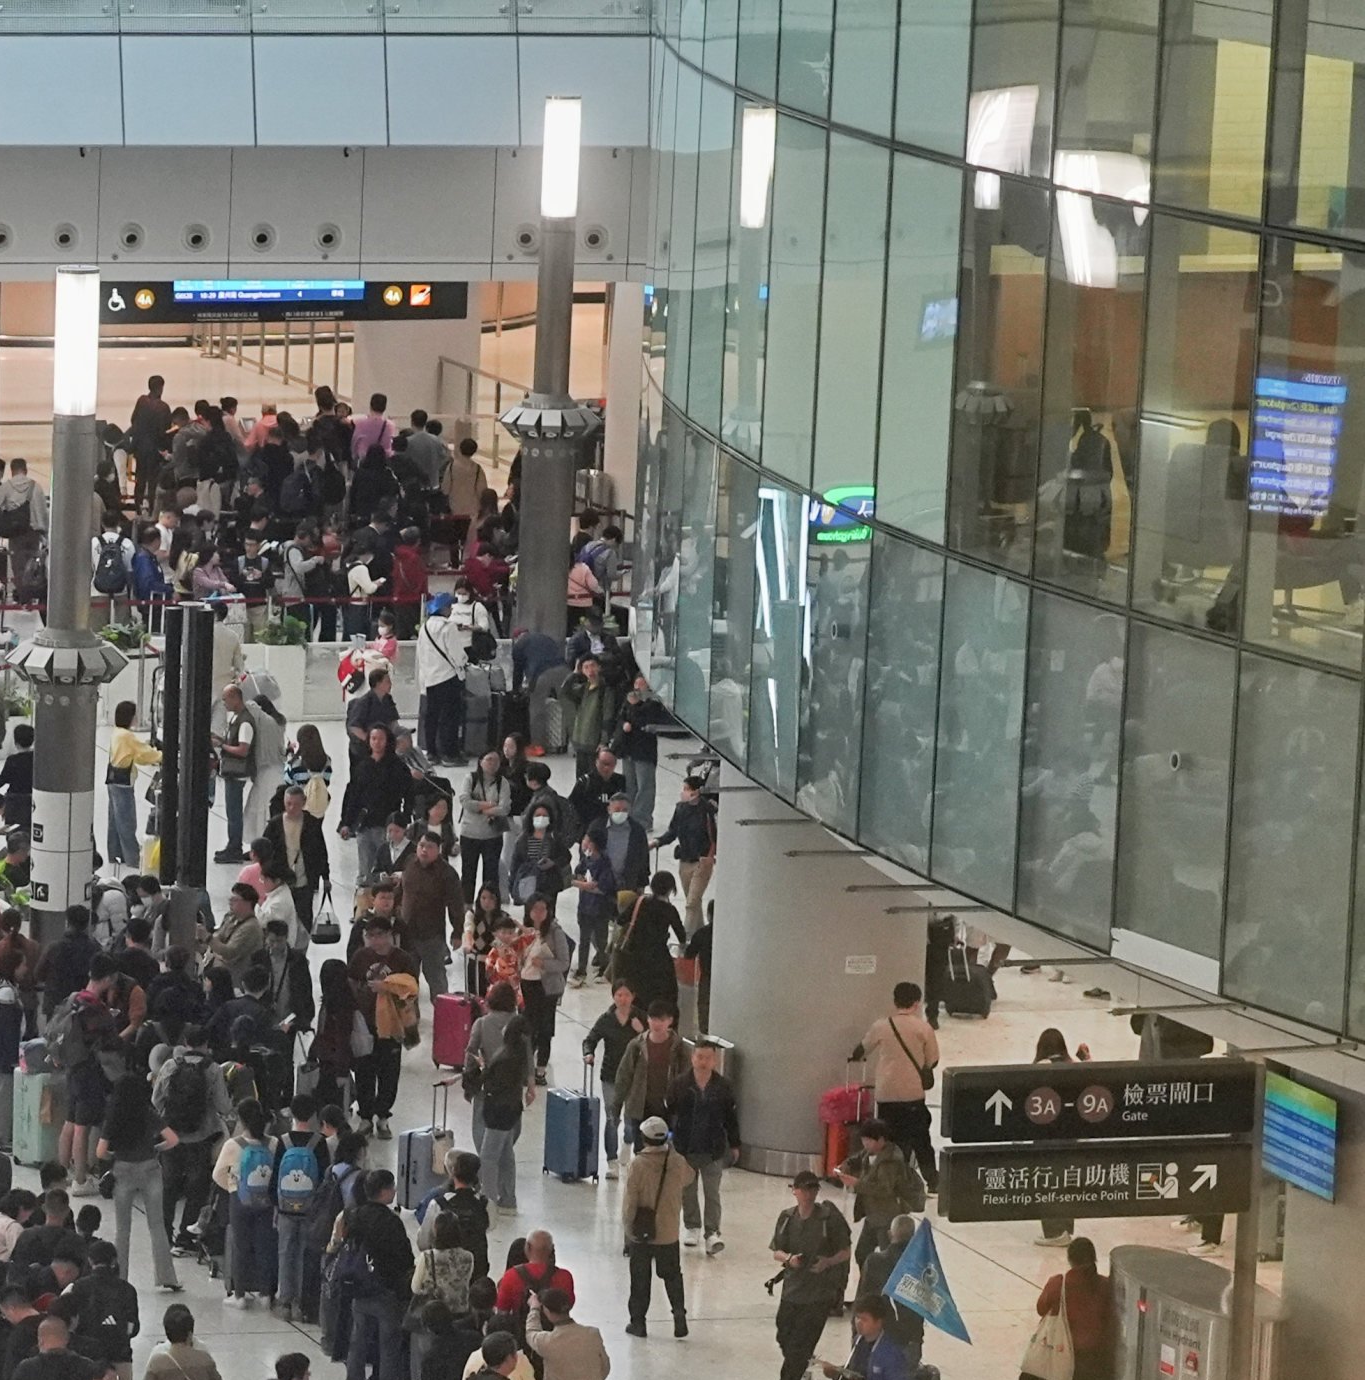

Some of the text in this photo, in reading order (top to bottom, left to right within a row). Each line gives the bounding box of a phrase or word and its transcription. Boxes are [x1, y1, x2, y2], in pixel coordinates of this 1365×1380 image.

[138, 293, 152, 306] 4A
[384, 290, 400, 303] 4A
[1122, 1082, 1215, 1107] 檢票閘口
[1030, 1096, 1056, 1115] 3A
[1083, 1094, 1108, 1113] 9A
[1122, 1110, 1148, 1121] Gate
[977, 1164, 1130, 1191] 「靈活行」自助機
[983, 1189, 1129, 1206] Flexi-trip Self-service Point
